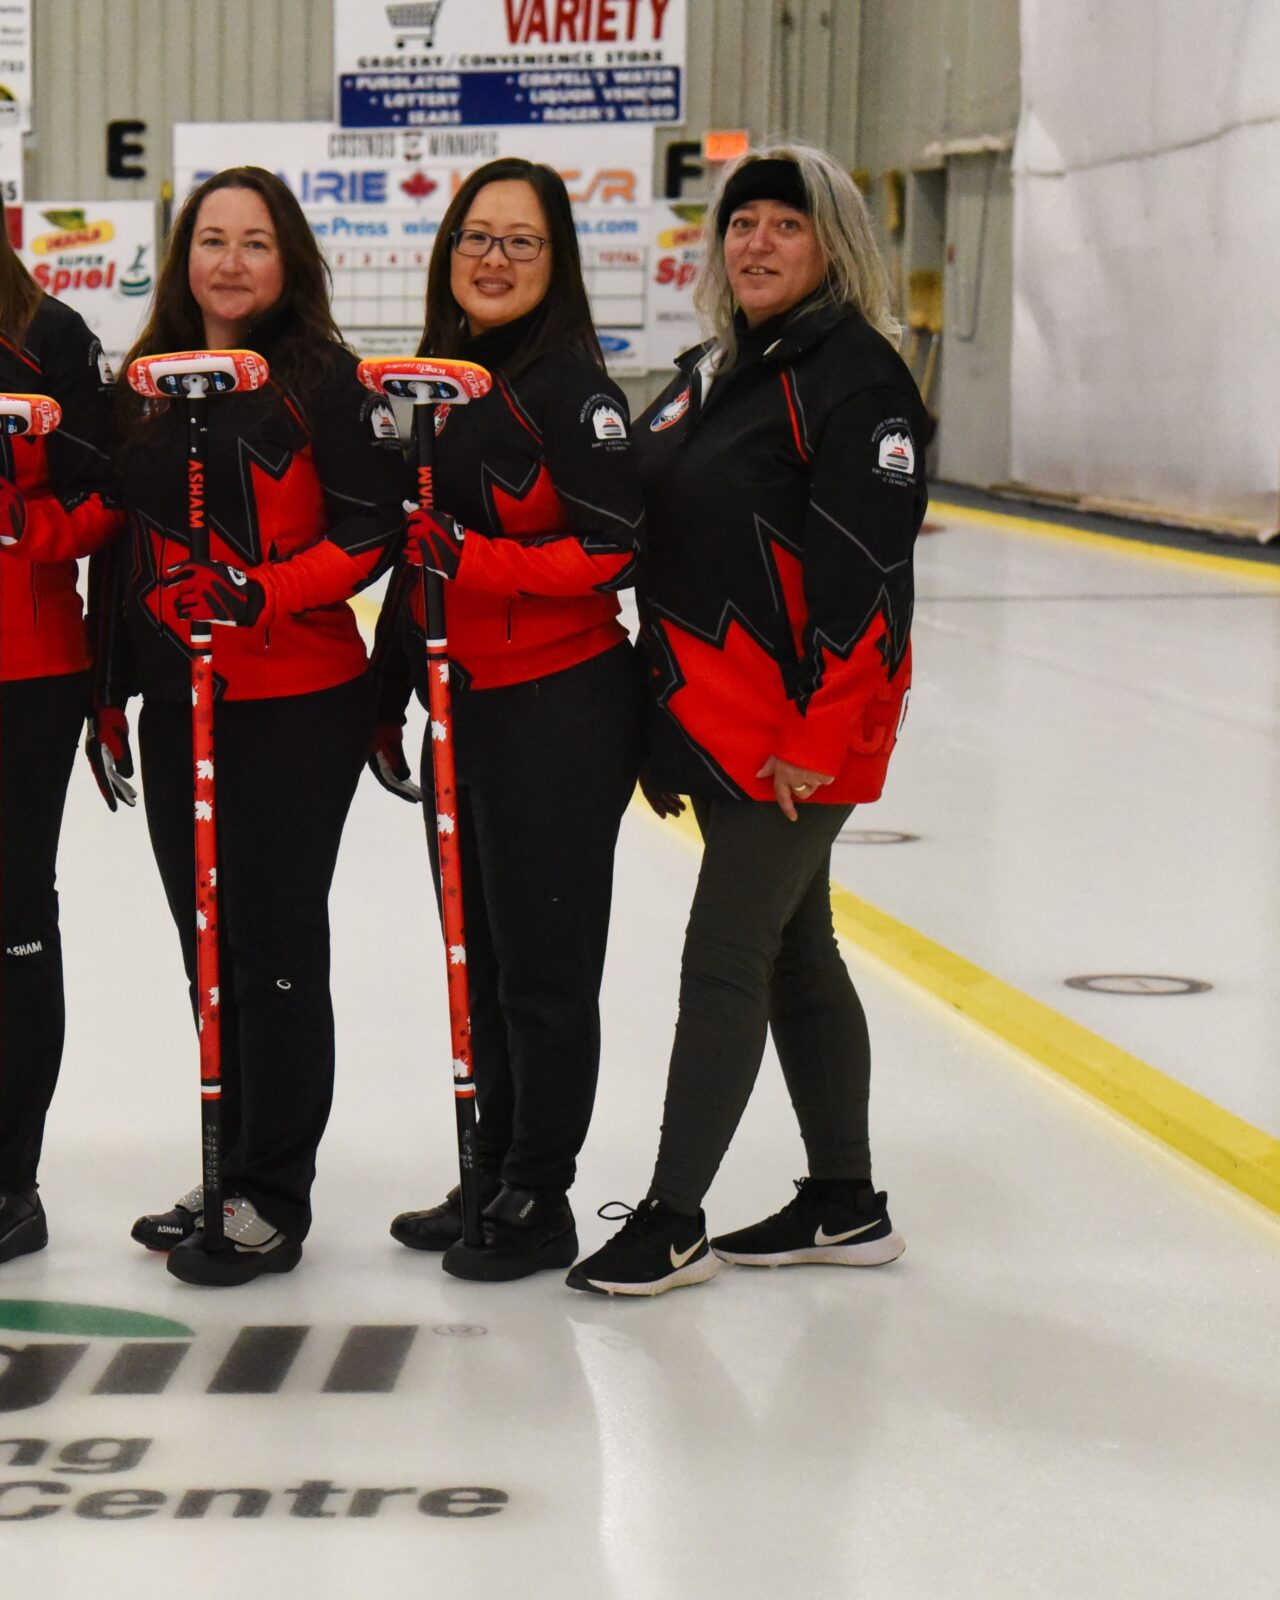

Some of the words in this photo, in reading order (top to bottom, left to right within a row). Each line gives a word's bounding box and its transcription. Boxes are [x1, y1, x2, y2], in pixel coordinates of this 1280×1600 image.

[503, 0, 671, 44] VARIETY
[607, 51, 663, 63] STORE
[383, 92, 460, 108] LOTTERY
[106, 120, 147, 180] E
[665, 141, 703, 200] F
[331, 216, 389, 236] Press
[57, 254, 105, 266] SUPER
[599, 251, 641, 265] TOTAL
[32, 261, 117, 296] Spiel
[188, 459, 205, 529] ASHAM
[417, 466, 434, 510] HAM
[6, 940, 43, 956] ASHAM
[157, 1224, 184, 1236] ASHAM
